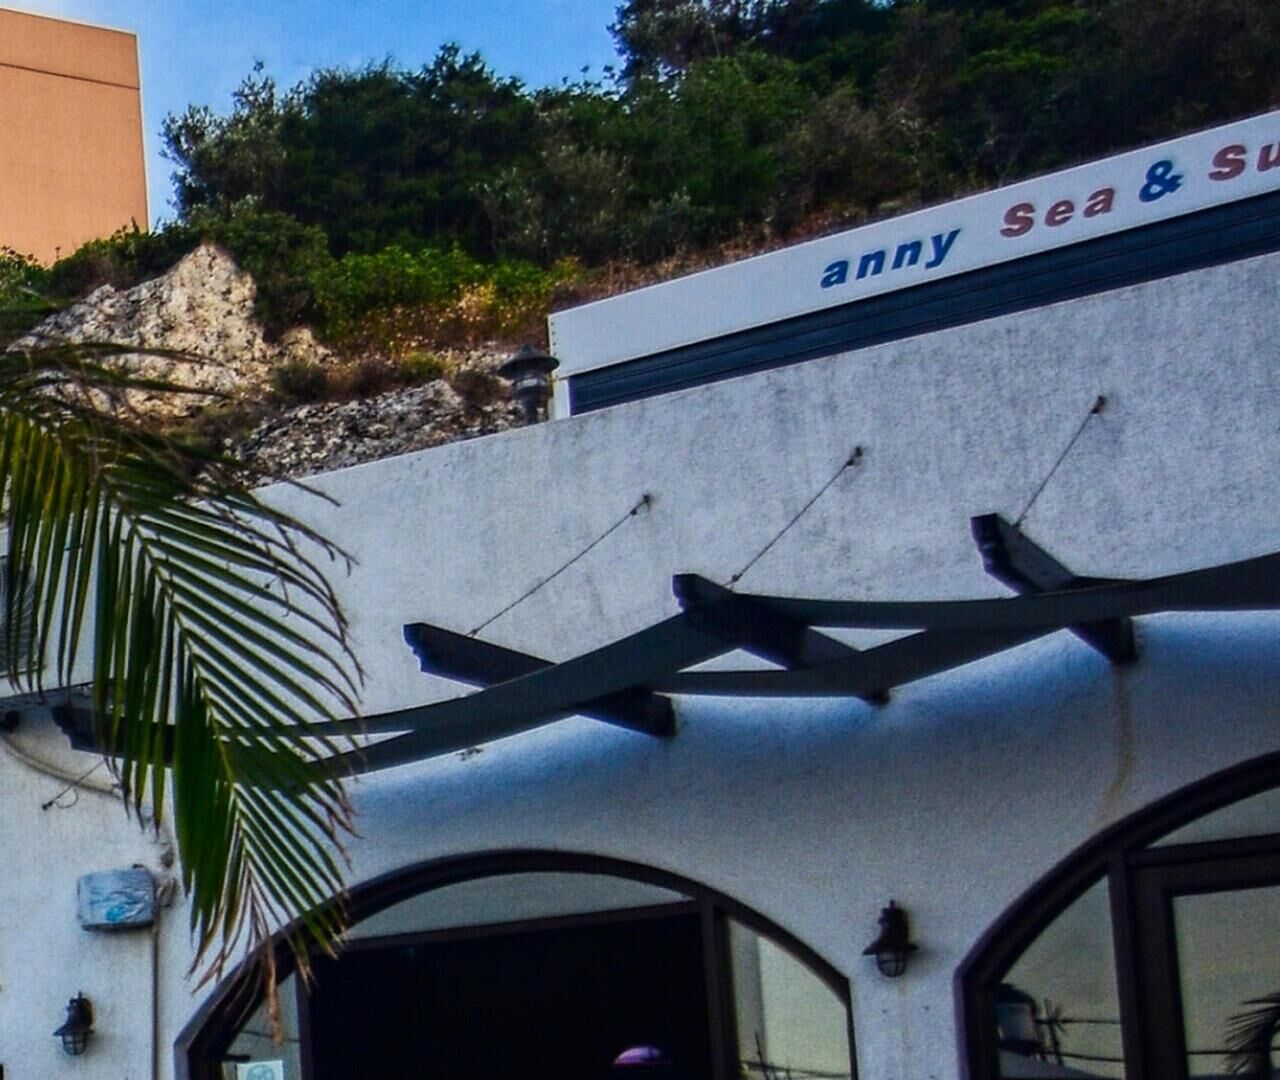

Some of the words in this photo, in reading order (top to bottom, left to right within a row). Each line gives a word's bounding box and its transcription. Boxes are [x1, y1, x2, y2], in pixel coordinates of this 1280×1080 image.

[819, 227, 962, 289] anny
[999, 186, 1116, 239] Sea
[1138, 160, 1184, 203] &
